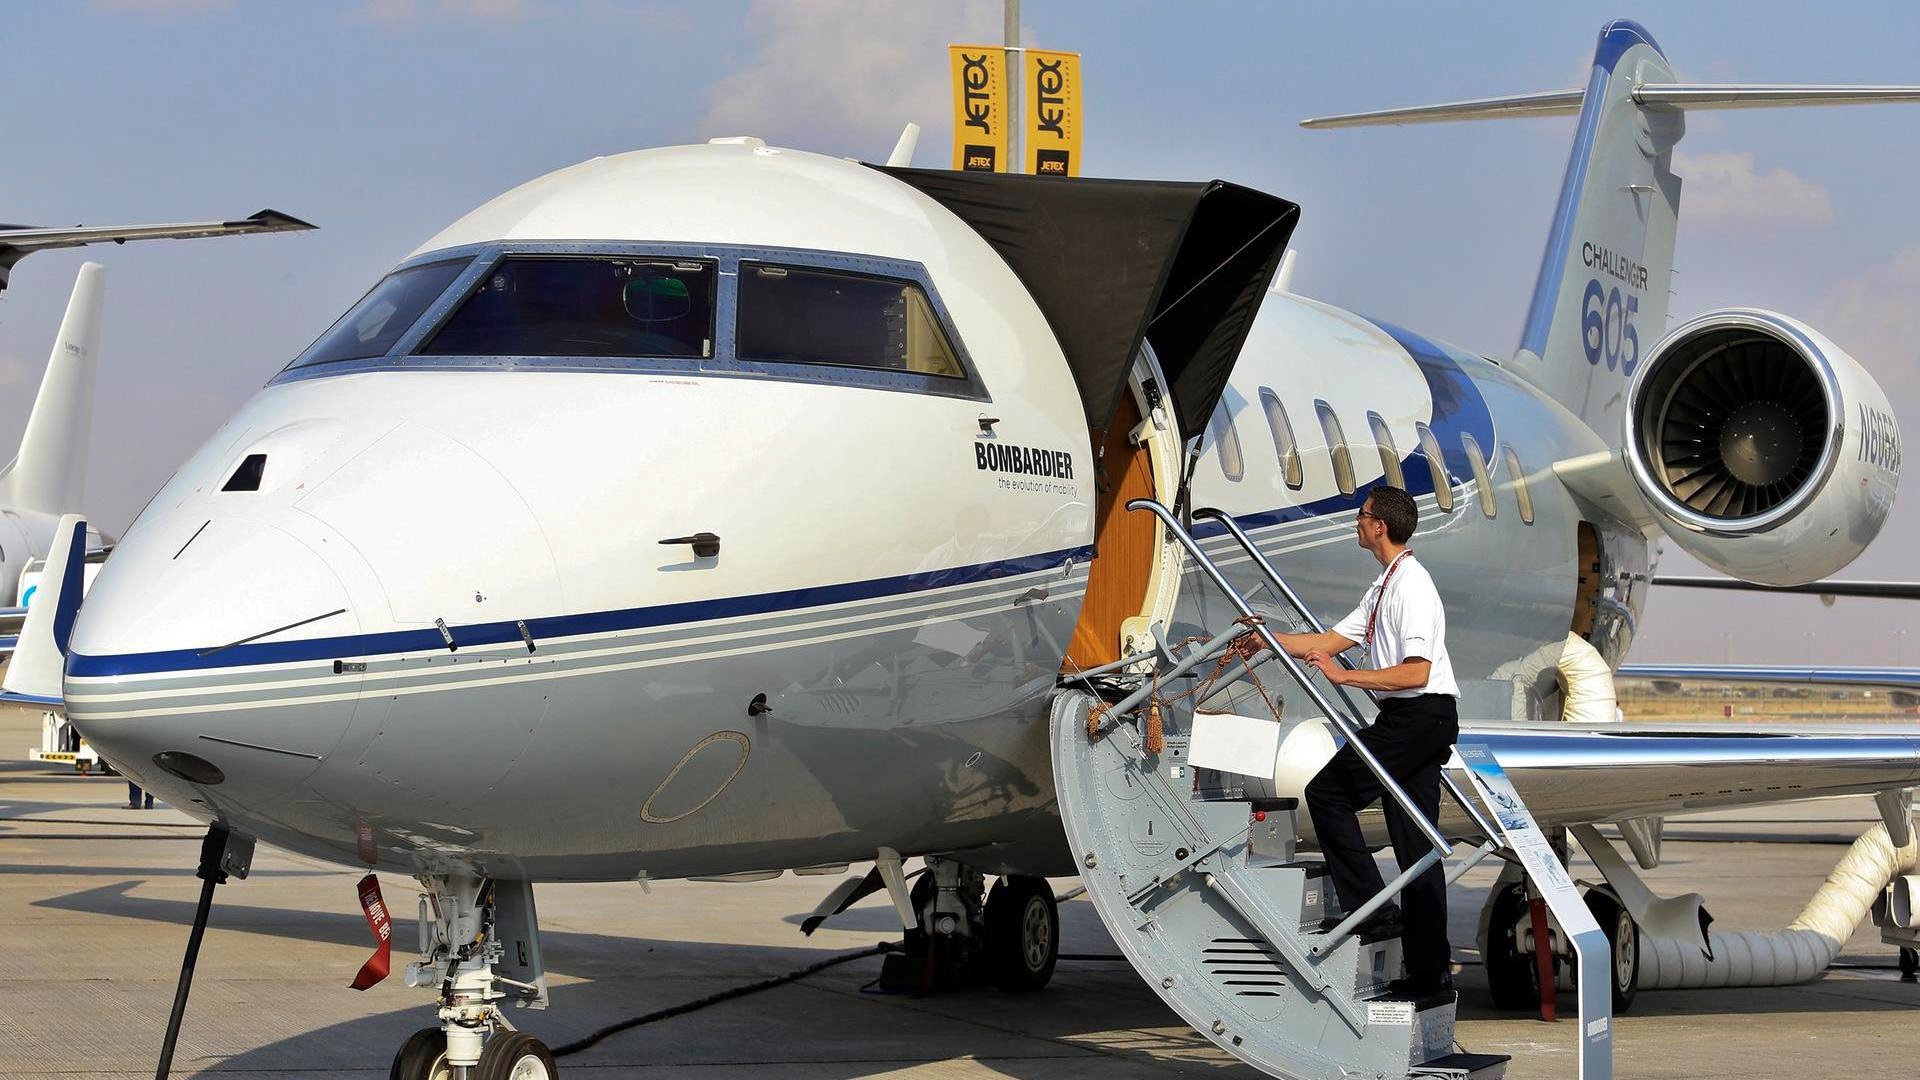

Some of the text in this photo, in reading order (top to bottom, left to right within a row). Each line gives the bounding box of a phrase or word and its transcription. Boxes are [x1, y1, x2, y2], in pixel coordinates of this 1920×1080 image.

[962, 54, 990, 134] JETEX
[1036, 58, 1064, 139] JETEX
[968, 156, 991, 167] JETEX
[1041, 160, 1065, 171] JETEX
[1582, 241, 1648, 291] CHALLENGER
[1581, 278, 1639, 377] 605
[974, 441, 1074, 480] BOMBARDIER
[998, 477, 1078, 498] the evolution of mobility
[364, 891, 385, 925] REMOVE
